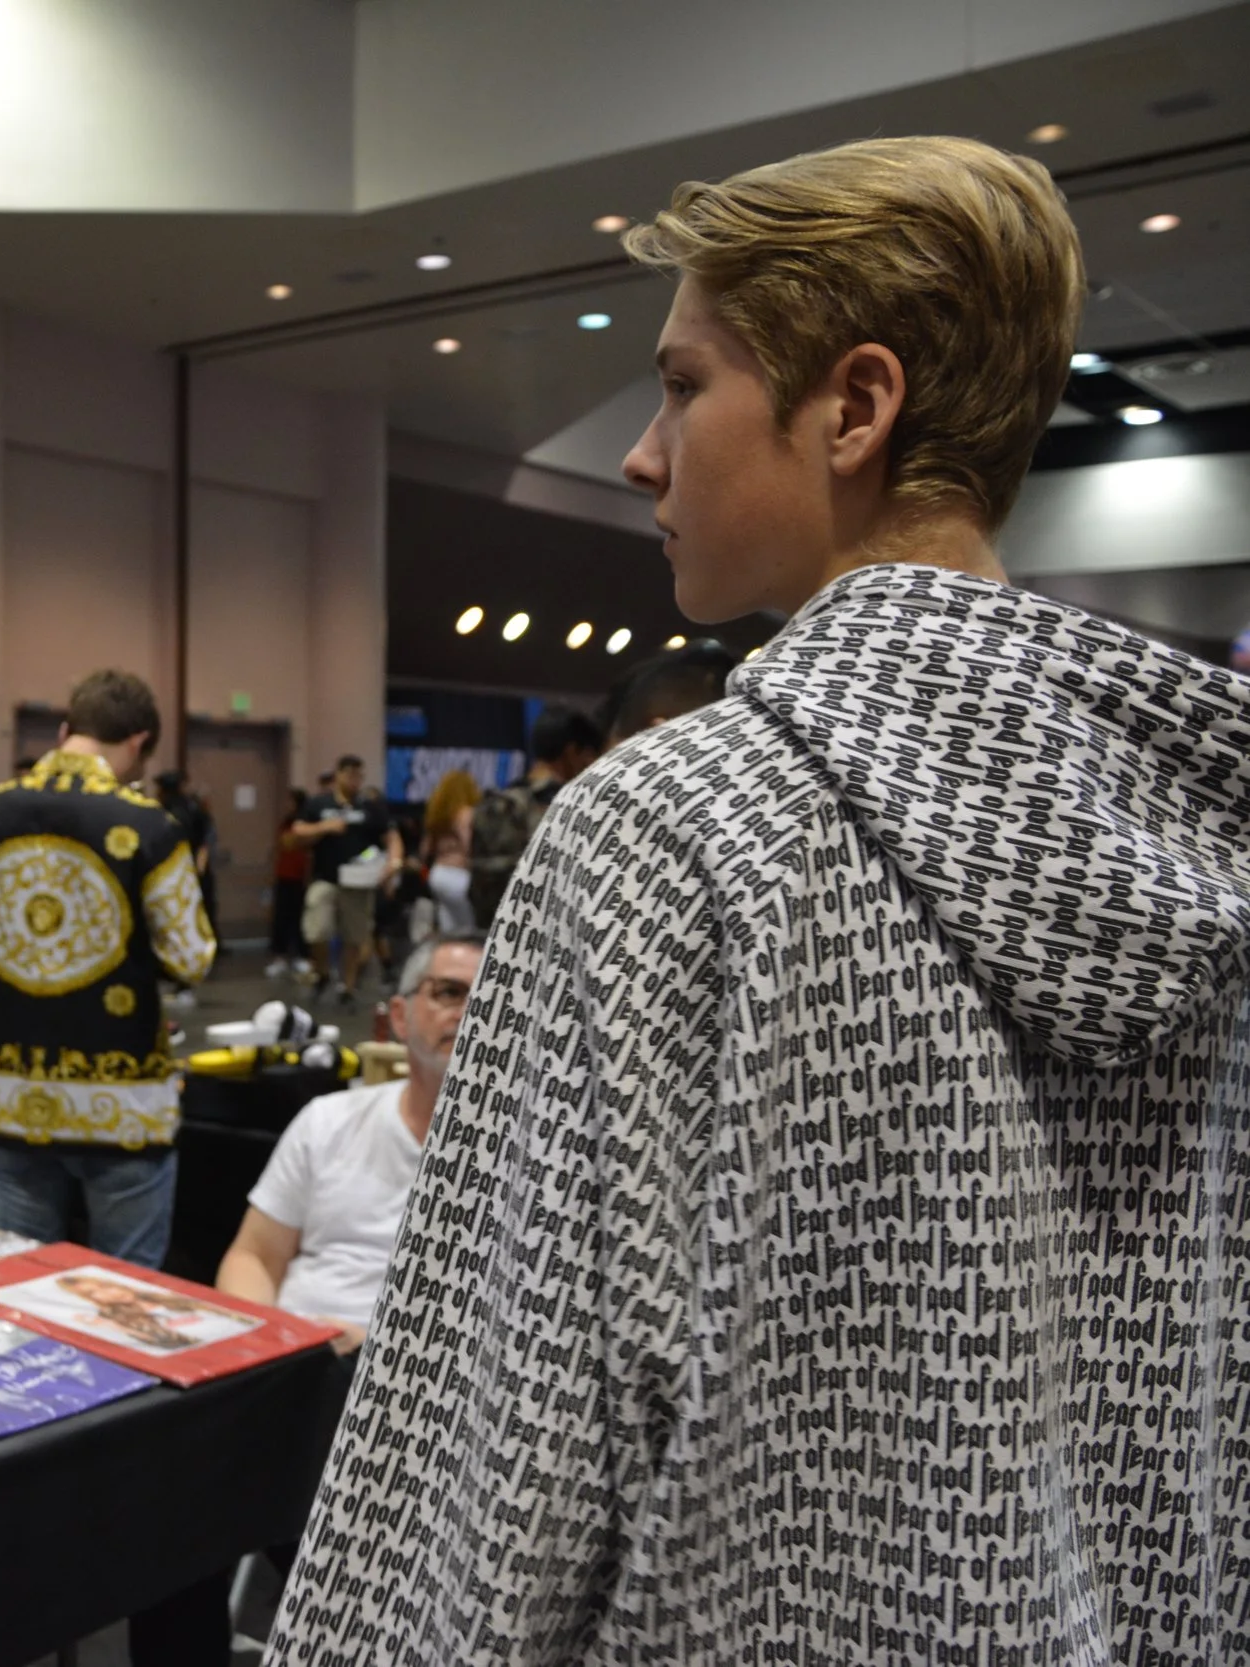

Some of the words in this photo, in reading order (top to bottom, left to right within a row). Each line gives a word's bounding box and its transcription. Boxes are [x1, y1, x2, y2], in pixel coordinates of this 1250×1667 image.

[904, 678, 958, 724] fear
[957, 656, 1012, 700] fear
[852, 693, 905, 738] fear
[888, 723, 942, 752] of
[940, 701, 995, 730] of
[987, 701, 1038, 748] god
[838, 736, 891, 766] of
[883, 742, 932, 789] god
[934, 725, 984, 770] god
[977, 745, 1035, 795] fear
[1032, 721, 1086, 772] fear
[650, 775, 706, 811] god
[724, 793, 768, 821] of
[925, 764, 981, 812] fear
[963, 795, 1021, 824] of
[1015, 771, 1074, 800] of
[634, 804, 667, 845] of
[738, 812, 796, 850] god
[913, 812, 969, 843] of
[959, 816, 1010, 864] god
[1012, 795, 1064, 842] god
[991, 889, 1049, 921] of
[1044, 867, 1103, 898] of
[1093, 867, 1147, 917] god
[988, 914, 1039, 964] god
[1040, 891, 1092, 941] god
[1086, 912, 1144, 965] fear
[1138, 889, 1194, 942] fear
[812, 920, 857, 976] fear
[863, 907, 886, 965] of
[890, 919, 931, 961] god
[1032, 935, 1090, 989] fear
[1125, 942, 1181, 974] of
[805, 963, 845, 1022] god
[850, 959, 897, 1016] fear
[902, 947, 925, 1006] of
[1072, 965, 1128, 996] of
[815, 1009, 837, 1066] of
[841, 1002, 883, 1063] god
[889, 998, 935, 1057] fear
[940, 990, 963, 1049] of
[1018, 991, 1076, 1021] of
[1066, 991, 1118, 1038] god
[801, 1059, 847, 1115] fear
[851, 1048, 876, 1107] of
[879, 1043, 920, 1102] god
[926, 1040, 973, 1097] fear
[440, 1103, 486, 1151] fear
[486, 1121, 510, 1169] of
[1099, 1125, 1121, 1181] of
[1121, 1128, 1162, 1182] god
[1167, 1128, 1207, 1185] fear
[801, 1147, 824, 1203] of
[827, 1143, 868, 1201] god
[874, 1137, 919, 1190] fear
[924, 1132, 946, 1190] of
[949, 1132, 990, 1190] god
[438, 1197, 481, 1236] god
[788, 1195, 834, 1248] fear
[838, 1187, 860, 1238] of
[863, 1180, 904, 1234] god
[910, 1178, 951, 1233] fear
[956, 1179, 982, 1237] of
[1080, 1169, 1122, 1224] fear
[1124, 1171, 1150, 1227] of
[1149, 1176, 1191, 1229] god
[1068, 1214, 1102, 1268] god
[1104, 1214, 1150, 1268] fear
[1153, 1219, 1179, 1273] of
[406, 1260, 452, 1306] fear
[452, 1278, 477, 1323] of
[789, 1278, 811, 1326] of
[814, 1272, 852, 1323] god
[859, 1267, 902, 1319] fear
[906, 1269, 925, 1322] of
[927, 1273, 966, 1325] god
[975, 1271, 1016, 1327] fear
[1088, 1260, 1128, 1311] god
[1131, 1260, 1178, 1314] fear
[1181, 1264, 1202, 1317] of
[386, 1304, 429, 1342] god
[423, 1307, 466, 1352] fear
[776, 1322, 818, 1370] fear
[822, 1311, 844, 1361] of
[847, 1310, 885, 1360] god
[892, 1310, 929, 1362] fear
[933, 1316, 957, 1371] of
[959, 1318, 1000, 1372] god
[1089, 1301, 1115, 1354] of
[1113, 1306, 1157, 1355] god
[1160, 1306, 1200, 1358] fear
[382, 1336, 410, 1381] of
[403, 1351, 446, 1388] god
[767, 1359, 802, 1411] god
[809, 1355, 852, 1404] fear
[856, 1351, 877, 1403] of
[879, 1357, 911, 1406] god
[916, 1358, 960, 1411] fear
[965, 1363, 991, 1417] of
[993, 1362, 1028, 1417] god
[356, 1365, 399, 1409] fear
[399, 1383, 426, 1426] of
[420, 1399, 458, 1433] god
[369, 1410, 415, 1454] fear
[415, 1430, 441, 1472] of
[1079, 1429, 1118, 1478] god
[1120, 1429, 1171, 1479] fear
[1173, 1434, 1195, 1486] of
[347, 1453, 391, 1488] god
[385, 1456, 429, 1500] fear
[764, 1443, 801, 1488] fear
[805, 1433, 828, 1482] of
[831, 1436, 866, 1483] god
[870, 1437, 904, 1487] fear
[907, 1446, 929, 1500] of
[931, 1452, 973, 1503] god
[981, 1452, 1025, 1507] fear
[343, 1485, 371, 1528] of
[363, 1499, 407, 1534] god
[892, 1485, 932, 1537] fear
[936, 1495, 962, 1549] of
[964, 1498, 1007, 1551] god
[358, 1530, 386, 1572] of
[378, 1547, 419, 1580] god
[1130, 1554, 1160, 1602] of
[1158, 1560, 1201, 1607] god
